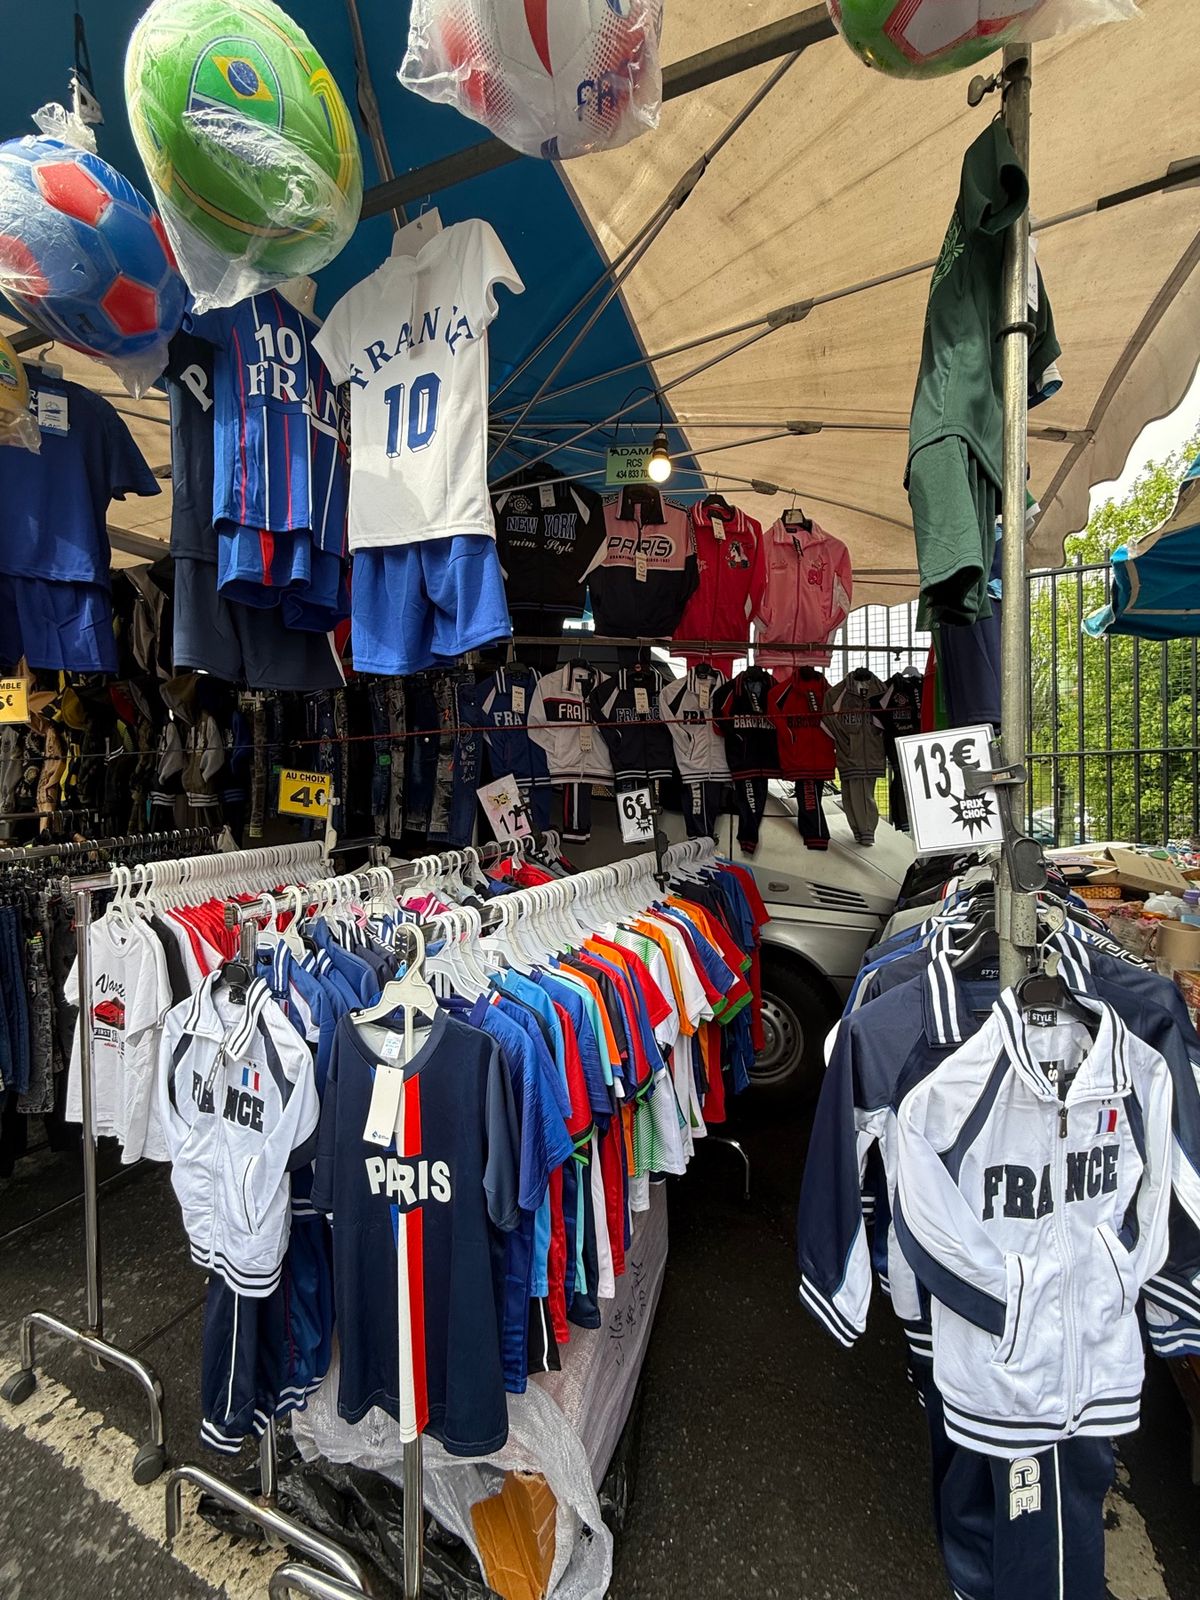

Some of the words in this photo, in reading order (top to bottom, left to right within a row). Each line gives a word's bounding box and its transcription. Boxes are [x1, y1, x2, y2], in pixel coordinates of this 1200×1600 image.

[255, 323, 301, 365] 10
[384, 371, 442, 458] 10
[626, 459, 643, 468] RCS
[616, 470, 627, 479] 434
[506, 516, 539, 535] NEW
[544, 513, 578, 540] YORK
[607, 536, 670, 556] PARIS
[286, 772, 297, 780] AU
[300, 774, 326, 784] CHOIX
[914, 738, 981, 800] 13€
[960, 798, 984, 810] PRIX
[963, 808, 986, 820] CHOC
[1031, 1013, 1053, 1022] STYLE
[365, 1156, 452, 1205] PARIS
[982, 1144, 1120, 1221] FRANCE
